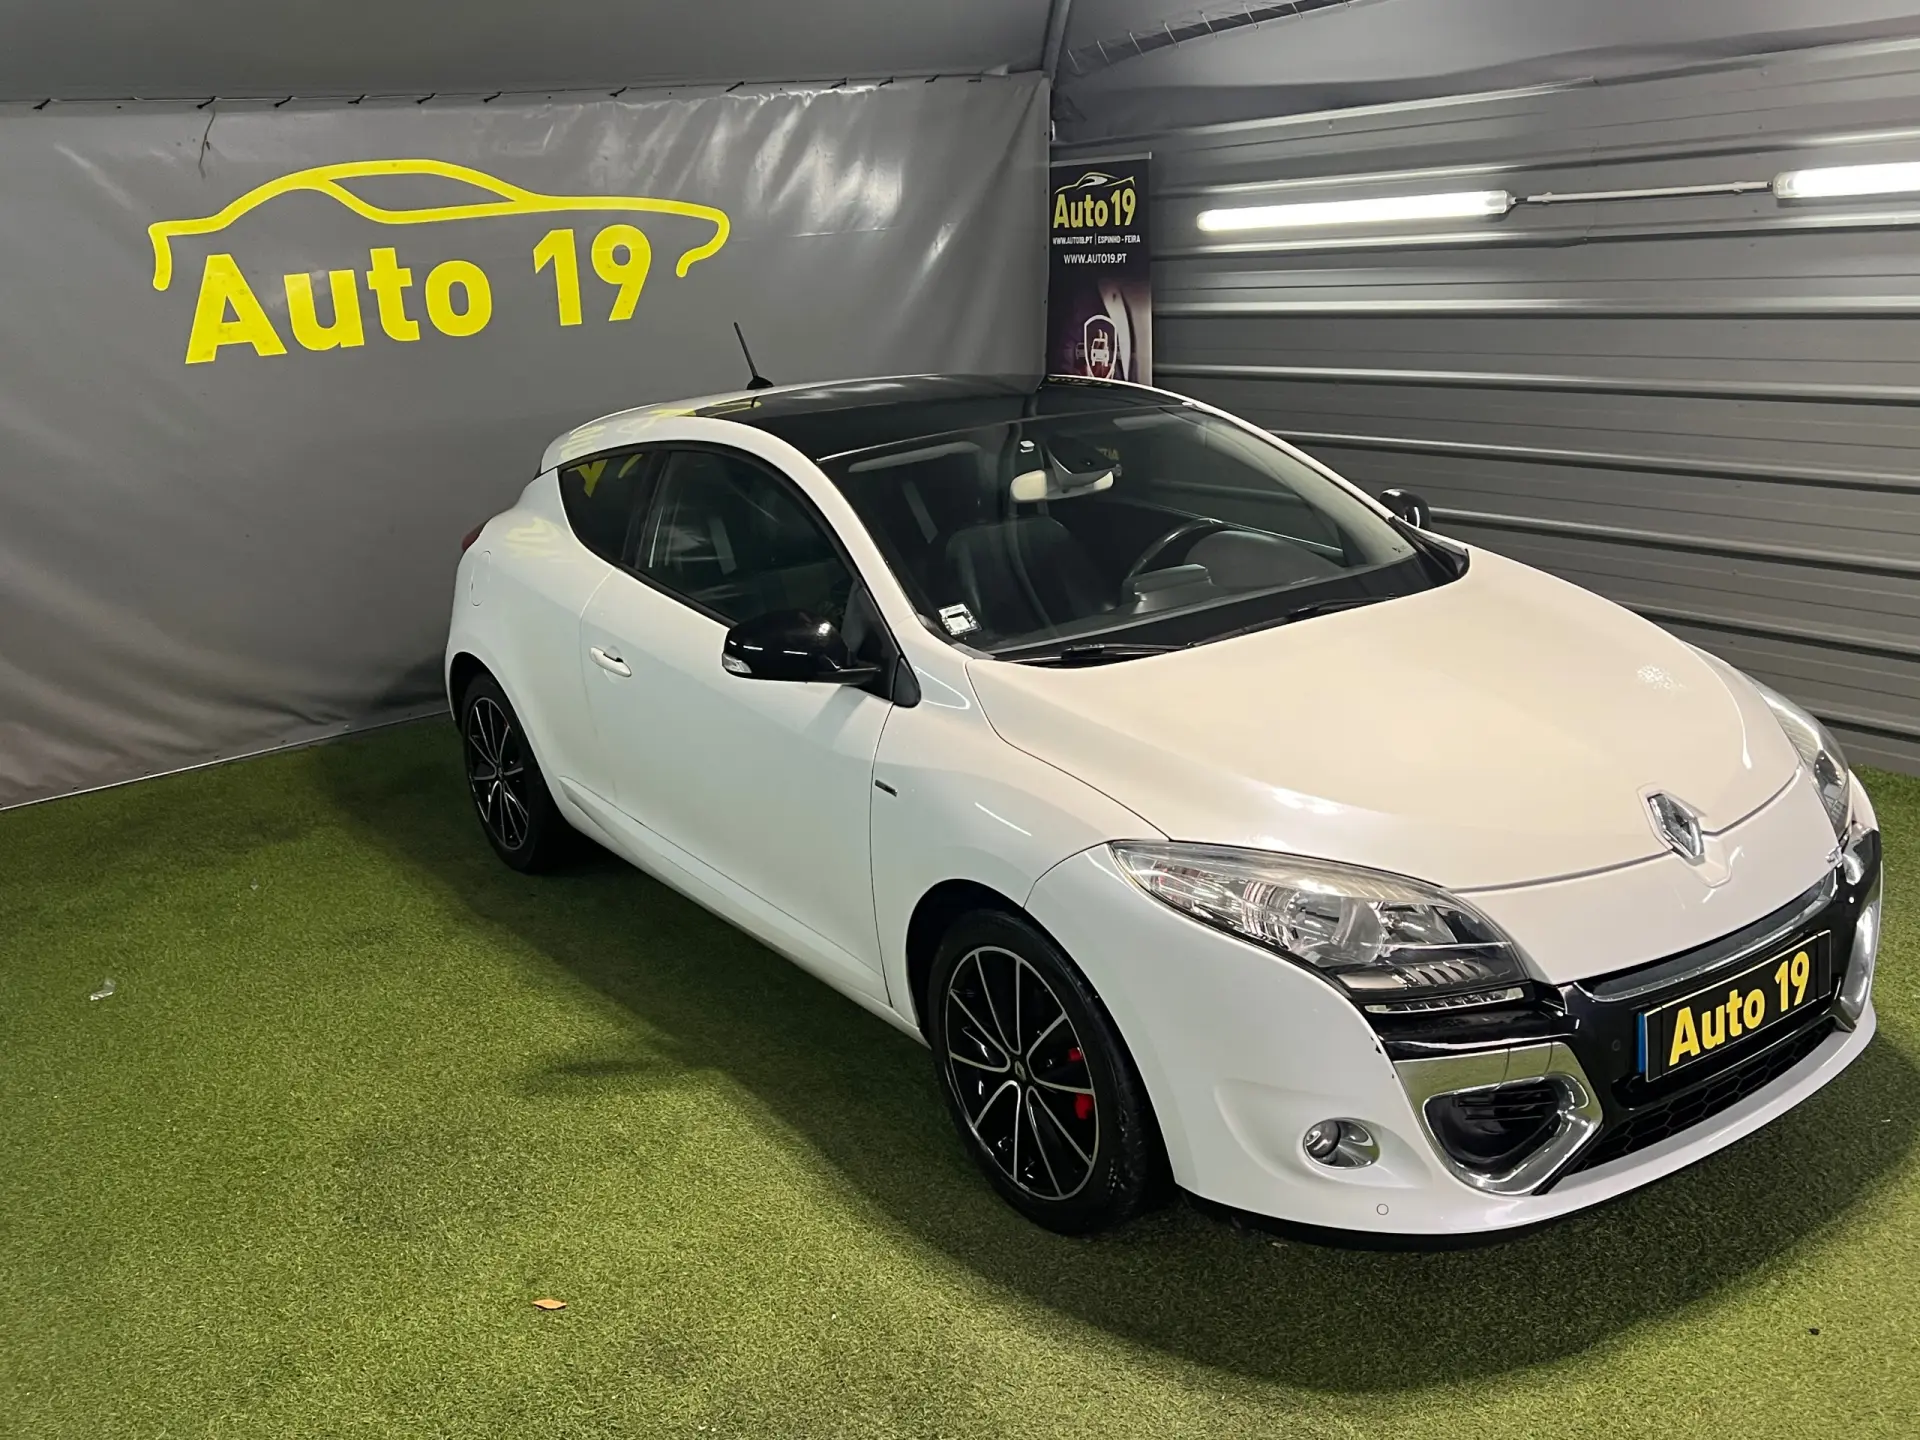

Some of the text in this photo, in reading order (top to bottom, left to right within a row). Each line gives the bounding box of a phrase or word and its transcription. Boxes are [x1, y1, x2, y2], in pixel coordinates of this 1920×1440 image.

[1053, 187, 1137, 229] Auto 19
[1063, 253, 1127, 264] WWW.AUTO19.PT
[1097, 235, 1121, 244] ESPINHO
[1124, 234, 1141, 244] FEIRA
[184, 223, 654, 366] Auto 19
[1668, 951, 1810, 1067] Auto 19
